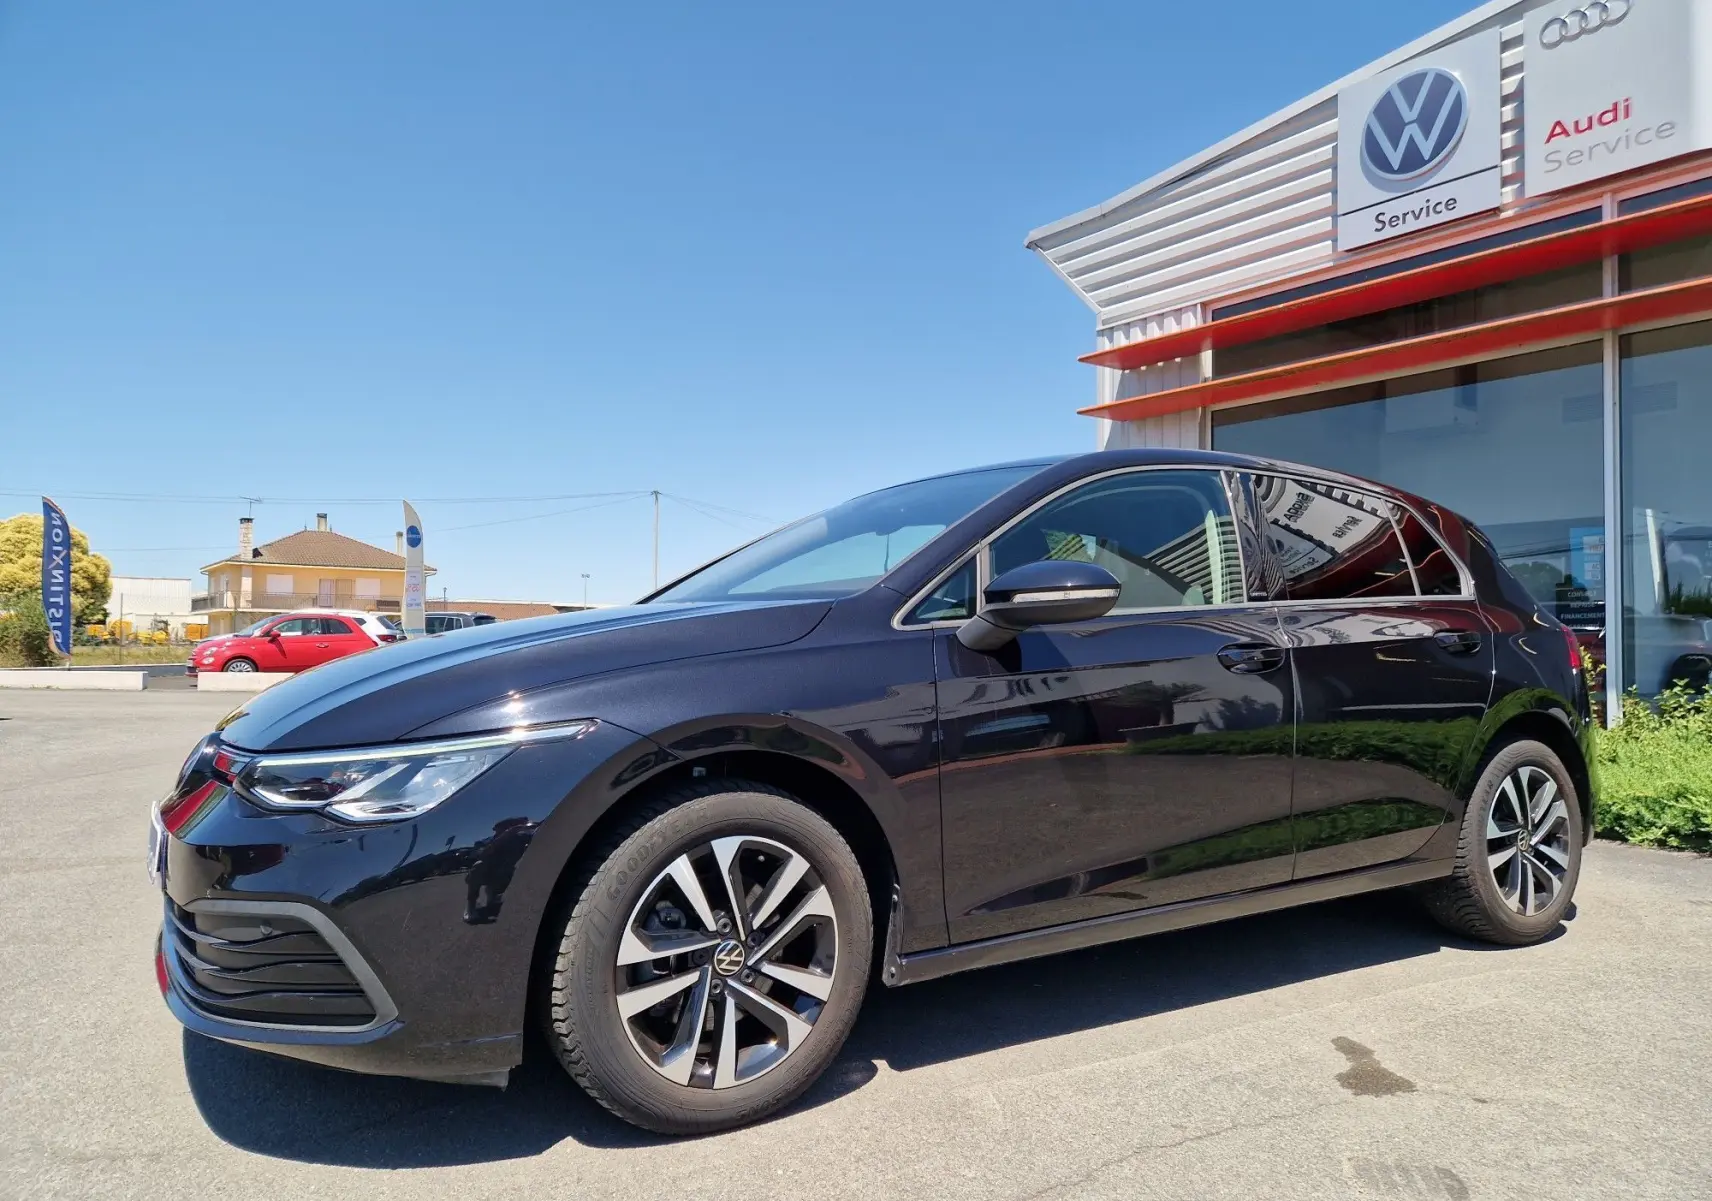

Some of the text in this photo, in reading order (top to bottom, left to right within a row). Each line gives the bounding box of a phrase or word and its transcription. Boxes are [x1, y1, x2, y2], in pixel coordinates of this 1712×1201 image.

[1544, 97, 1633, 145] Audi
[1543, 119, 1677, 175] Service
[1373, 196, 1458, 233] Service
